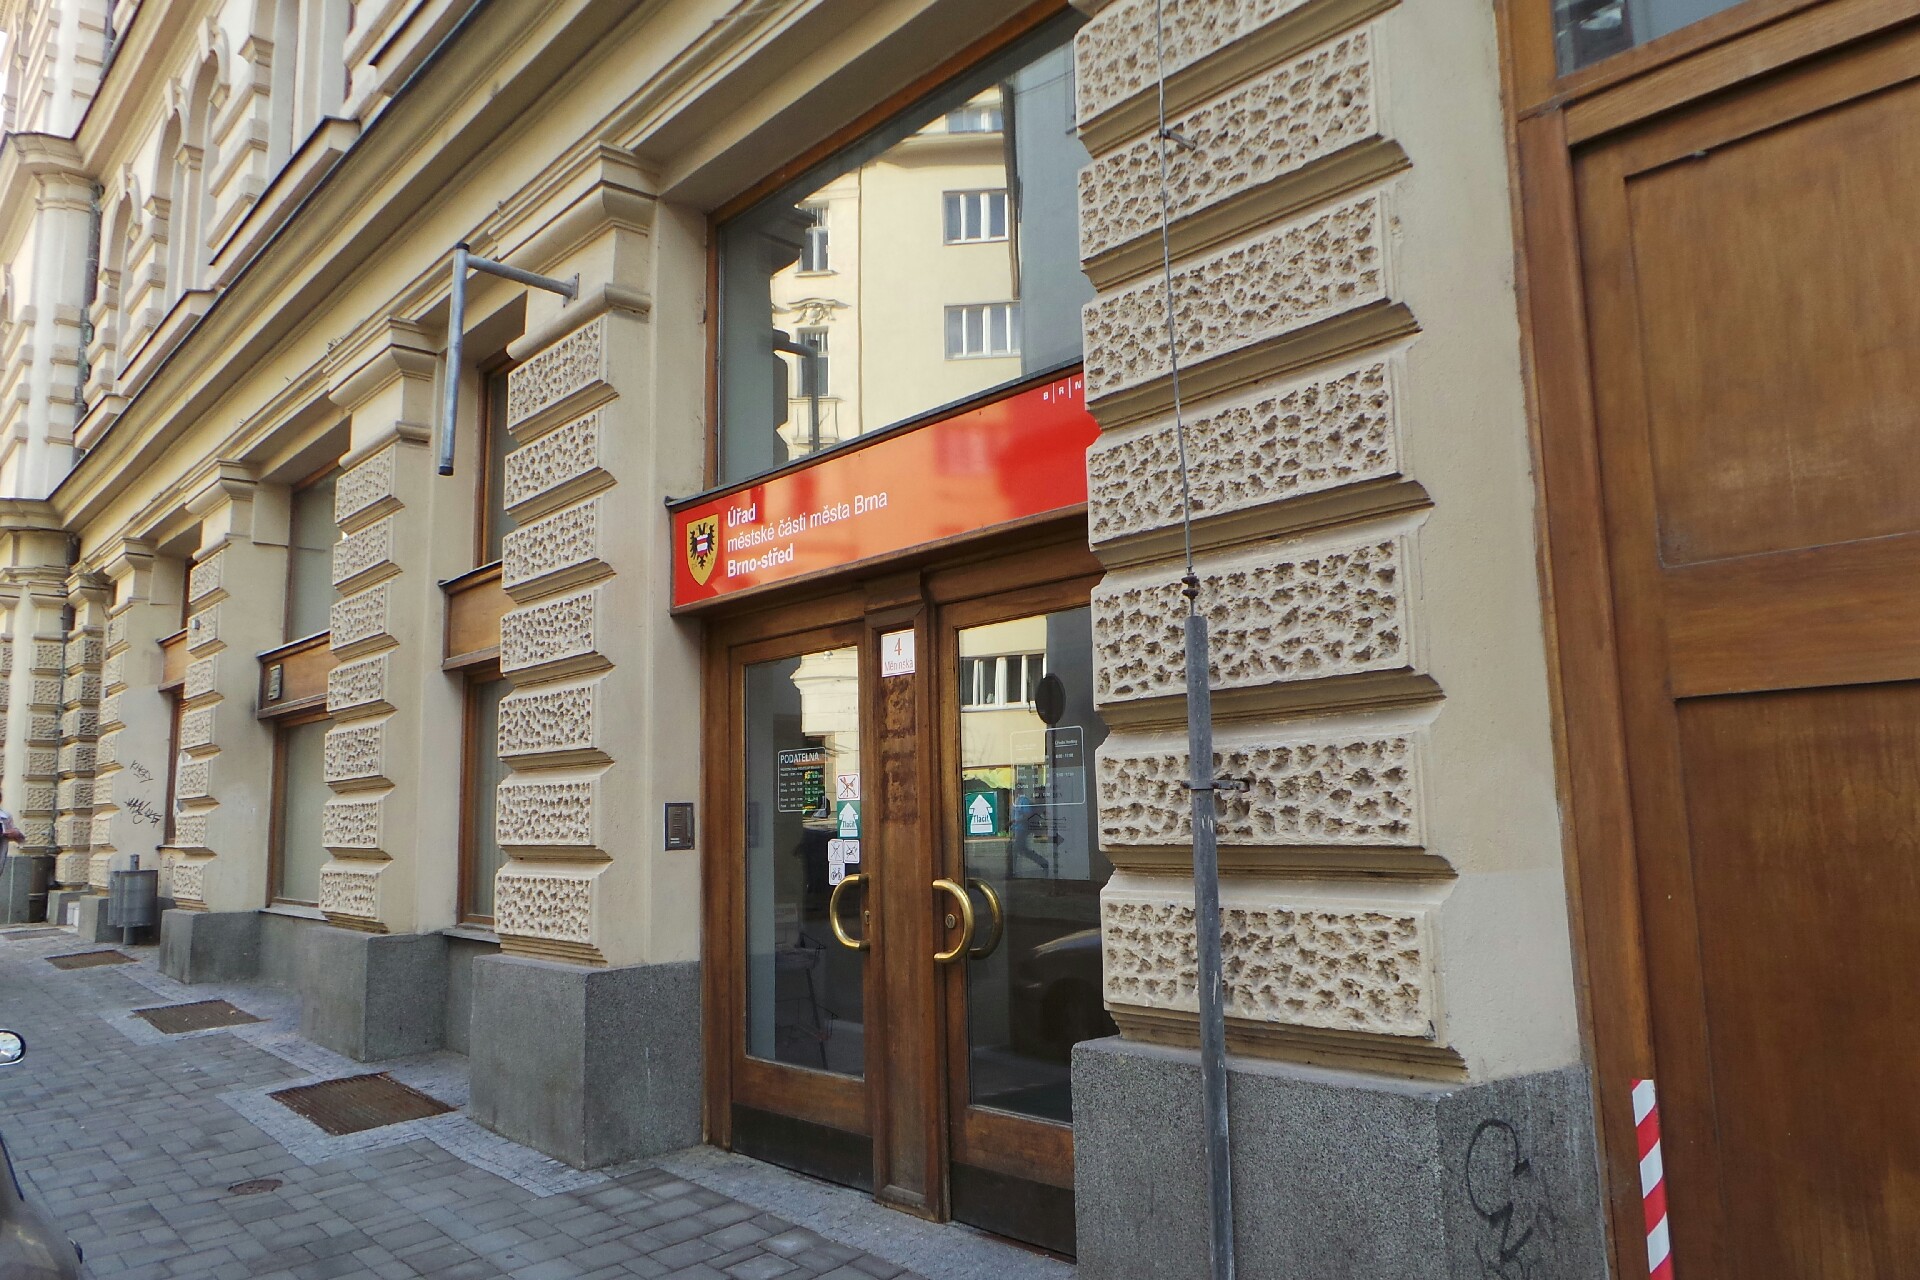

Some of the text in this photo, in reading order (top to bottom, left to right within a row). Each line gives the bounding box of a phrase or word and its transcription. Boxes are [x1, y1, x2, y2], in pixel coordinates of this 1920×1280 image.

[727, 503, 756, 528] Úřad
[727, 491, 888, 552] městské části města Brna
[727, 542, 794, 578] Brno-střed
[894, 637, 903, 656] 4
[885, 658, 914, 671] Měnnská
[780, 752, 820, 764] PODATELNA
